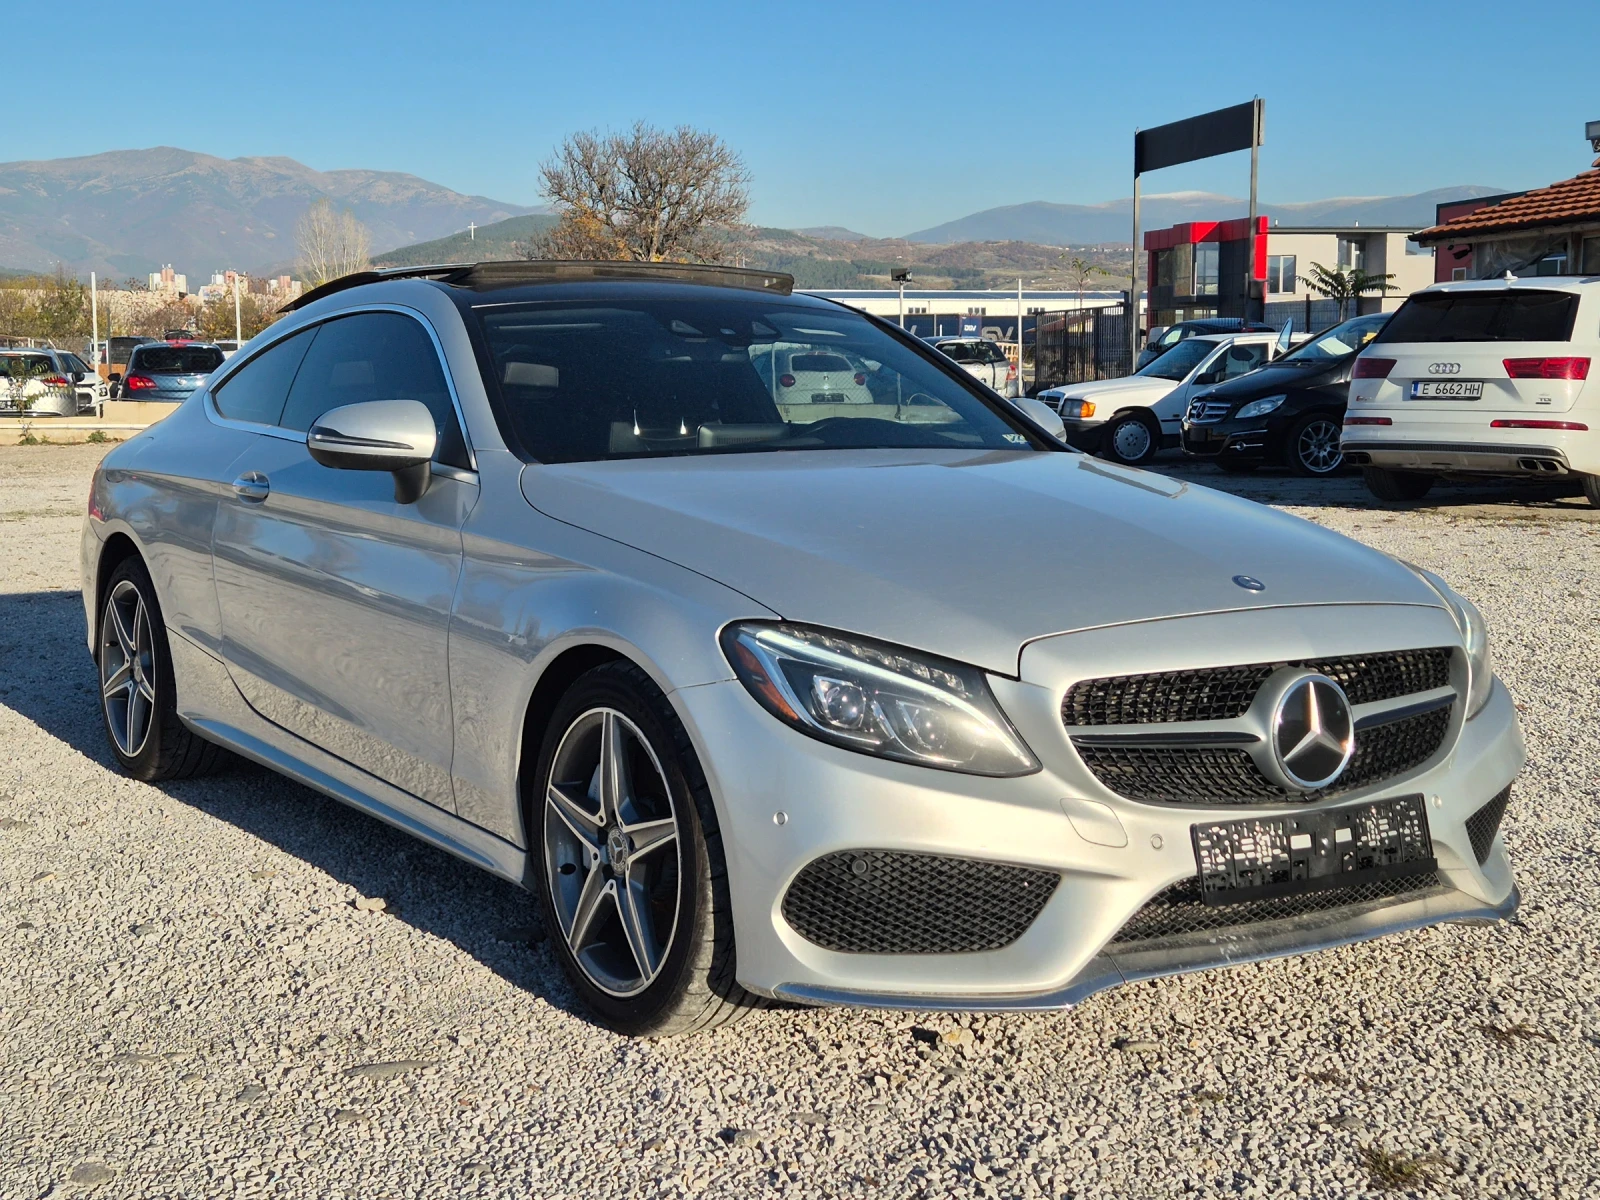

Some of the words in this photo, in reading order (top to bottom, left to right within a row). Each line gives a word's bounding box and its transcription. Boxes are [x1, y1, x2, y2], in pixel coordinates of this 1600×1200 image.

[981, 326, 1014, 341] SV
[1422, 383, 1430, 395] E
[1435, 383, 1463, 395] 6662
[1464, 383, 1481, 395] HH
